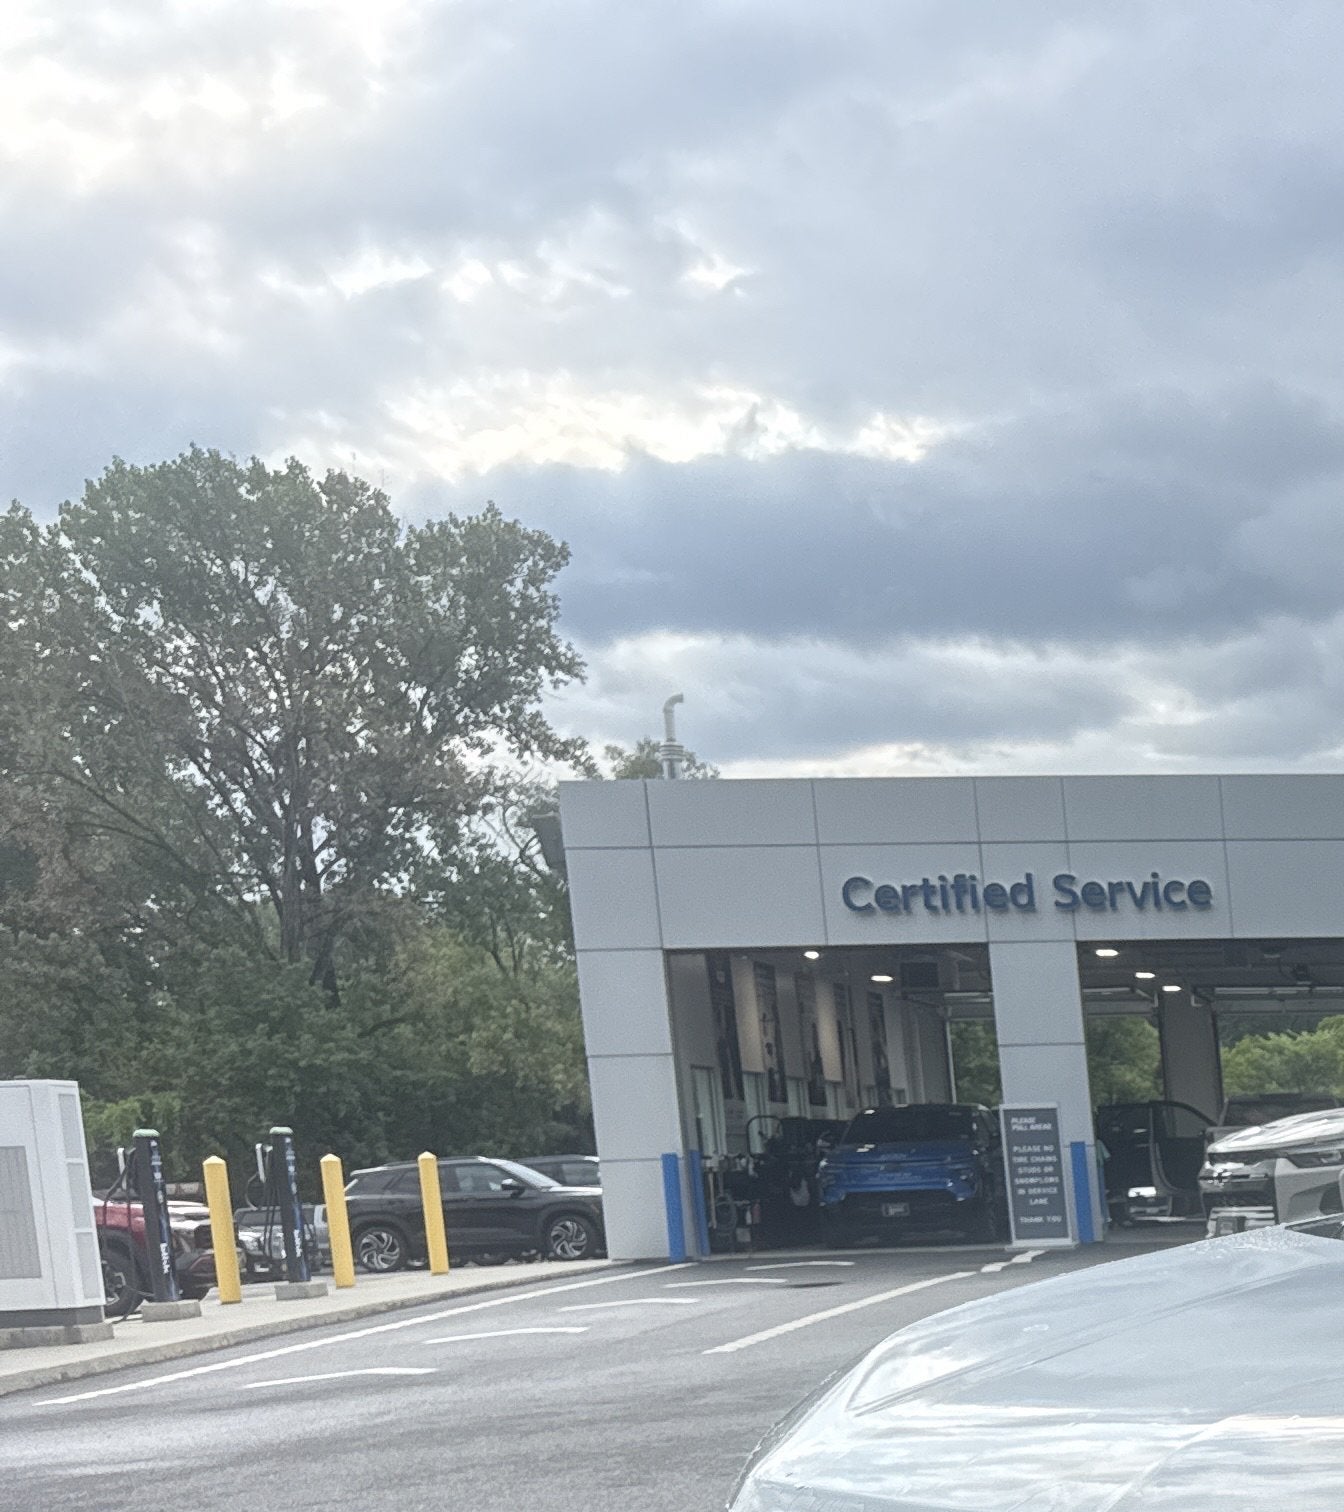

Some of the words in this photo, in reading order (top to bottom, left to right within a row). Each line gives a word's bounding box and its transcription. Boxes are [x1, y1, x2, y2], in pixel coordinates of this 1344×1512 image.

[842, 872, 1037, 914] Certified
[1053, 871, 1213, 912] Service
[1013, 1145, 1041, 1153] PLEASE
[1043, 1144, 1054, 1152] NO
[1030, 1155, 1057, 1163] CHAINS
[1029, 1197, 1049, 1206] LANE
